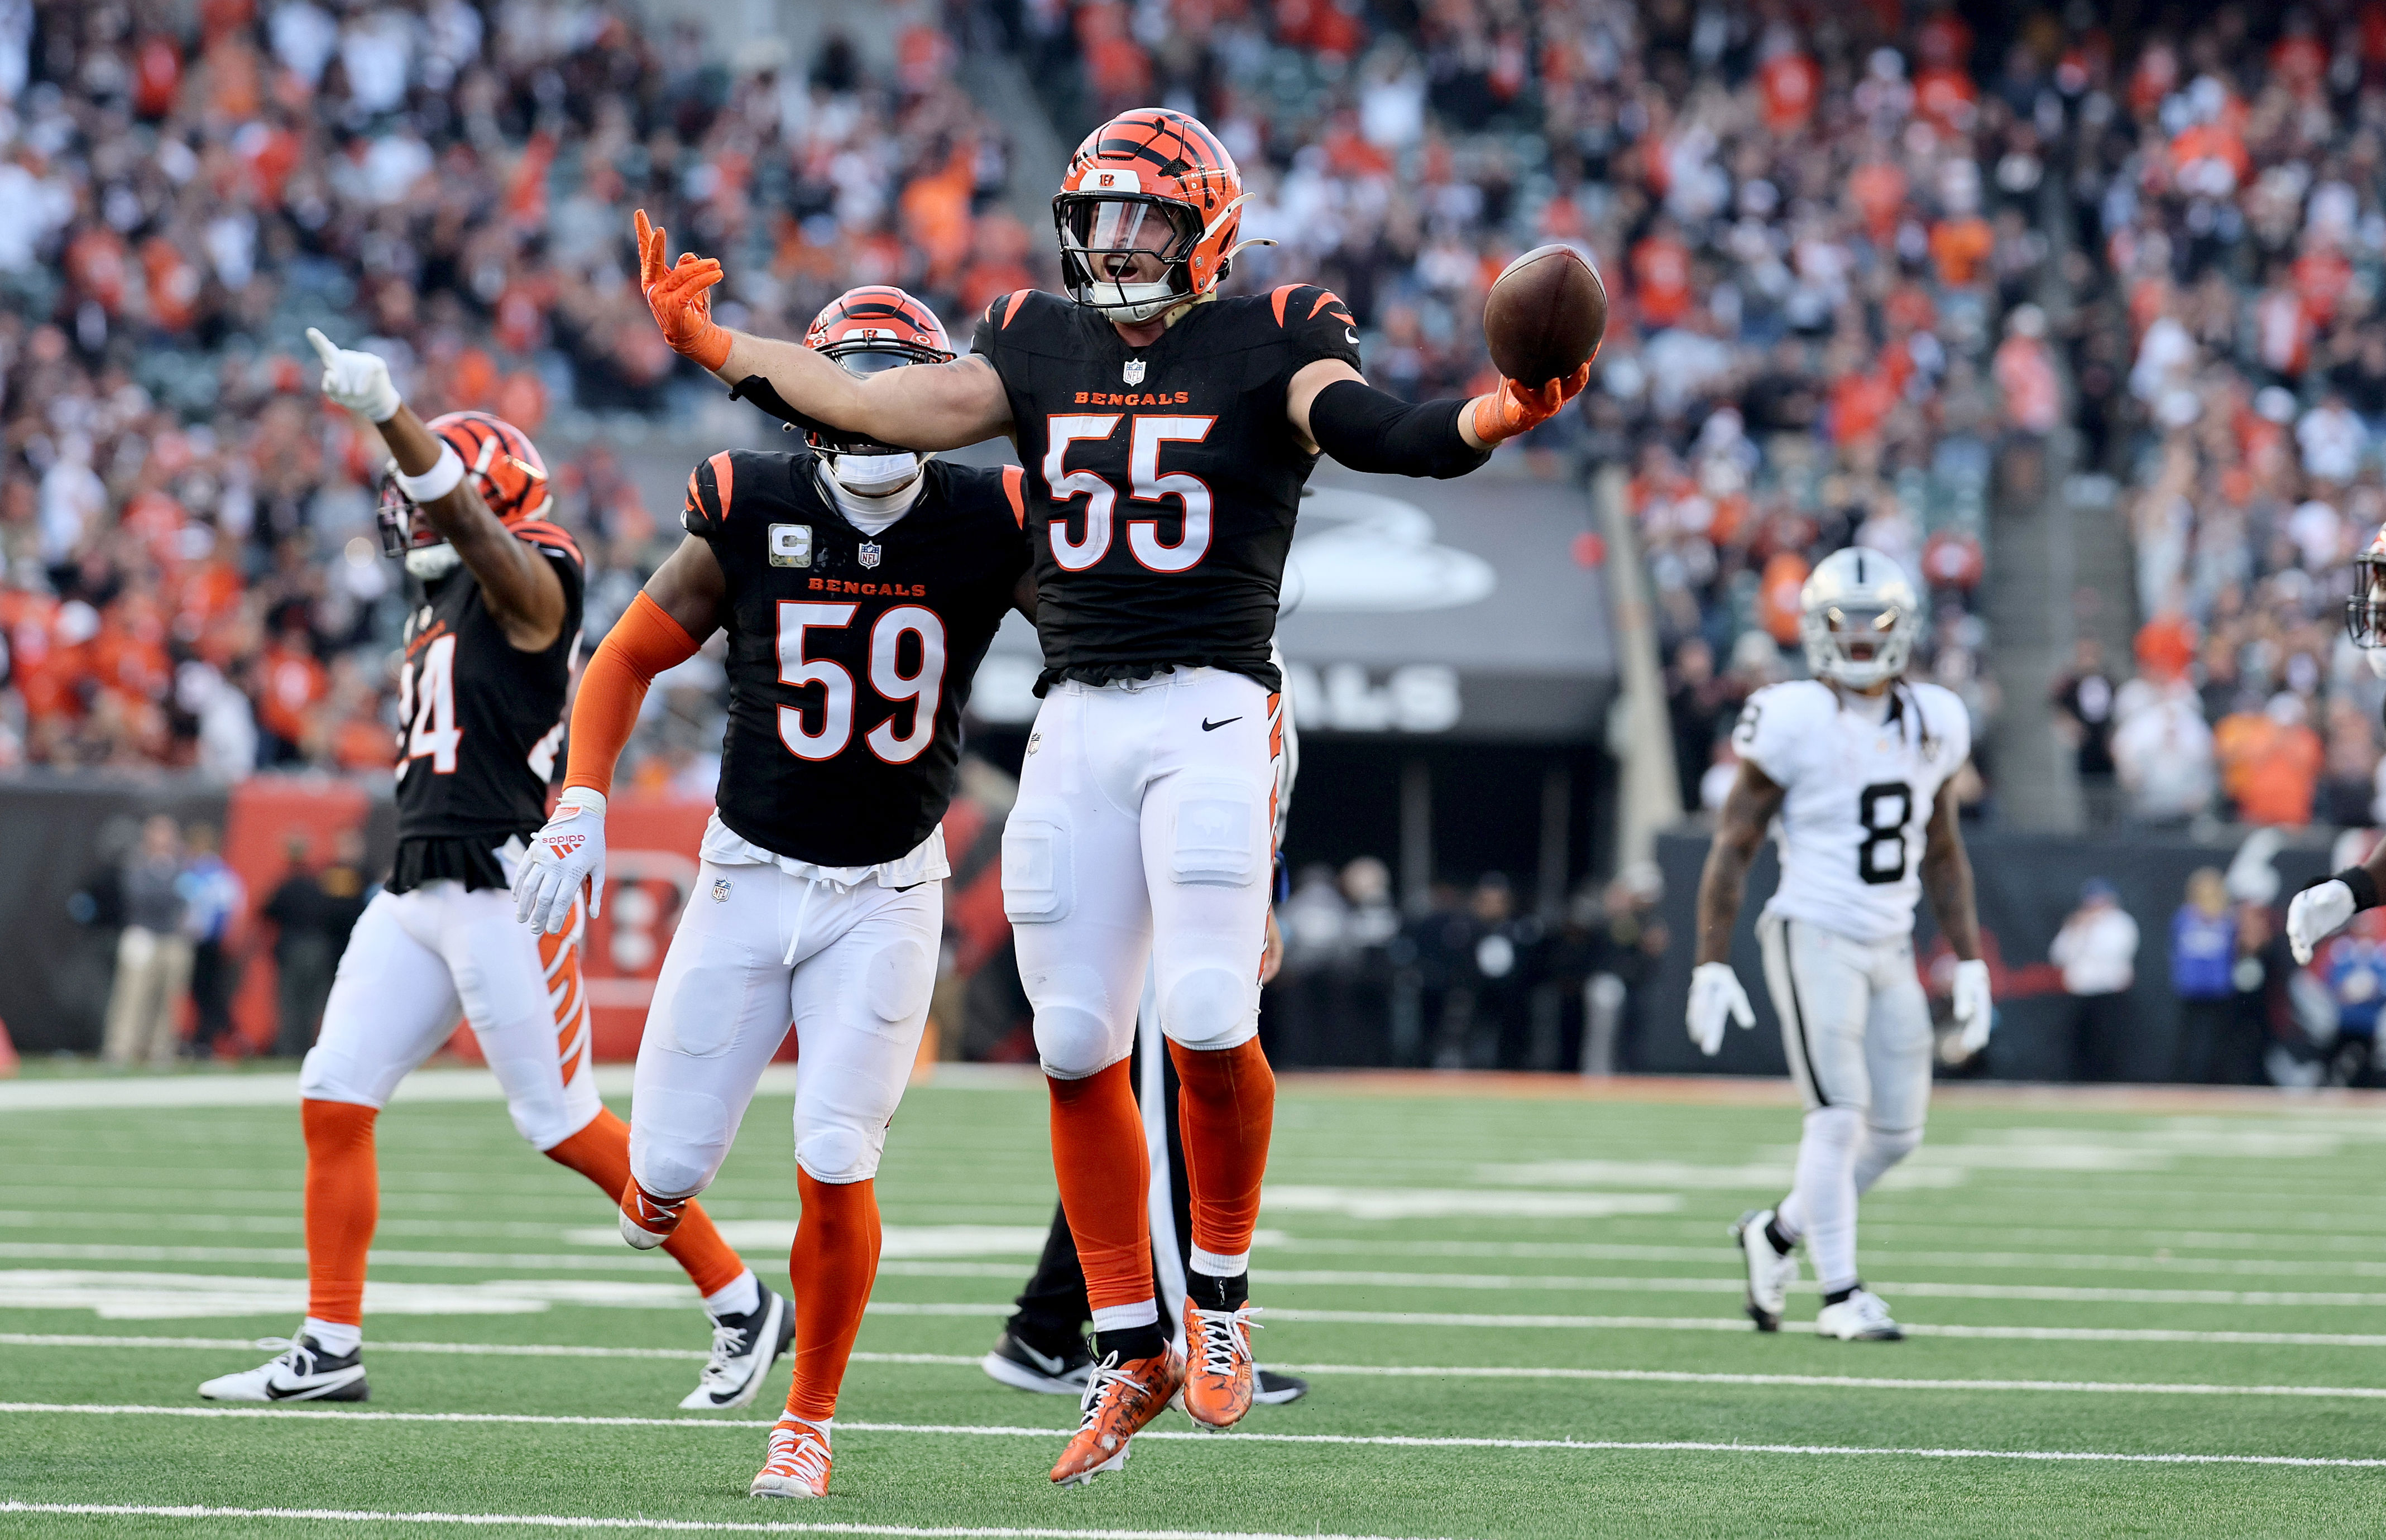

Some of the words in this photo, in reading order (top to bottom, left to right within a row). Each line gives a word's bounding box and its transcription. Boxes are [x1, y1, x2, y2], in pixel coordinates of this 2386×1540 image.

[1099, 174, 1115, 188] B
[1074, 391, 1189, 406] BENGALS
[1042, 412, 1219, 573] 55
[772, 526, 809, 556] C
[861, 553, 877, 564] NFL
[808, 578, 926, 597] BENGALS
[775, 599, 948, 765] 59
[542, 834, 586, 845] adidas
[1858, 781, 1911, 885] 8
[713, 886, 727, 899] NFL
